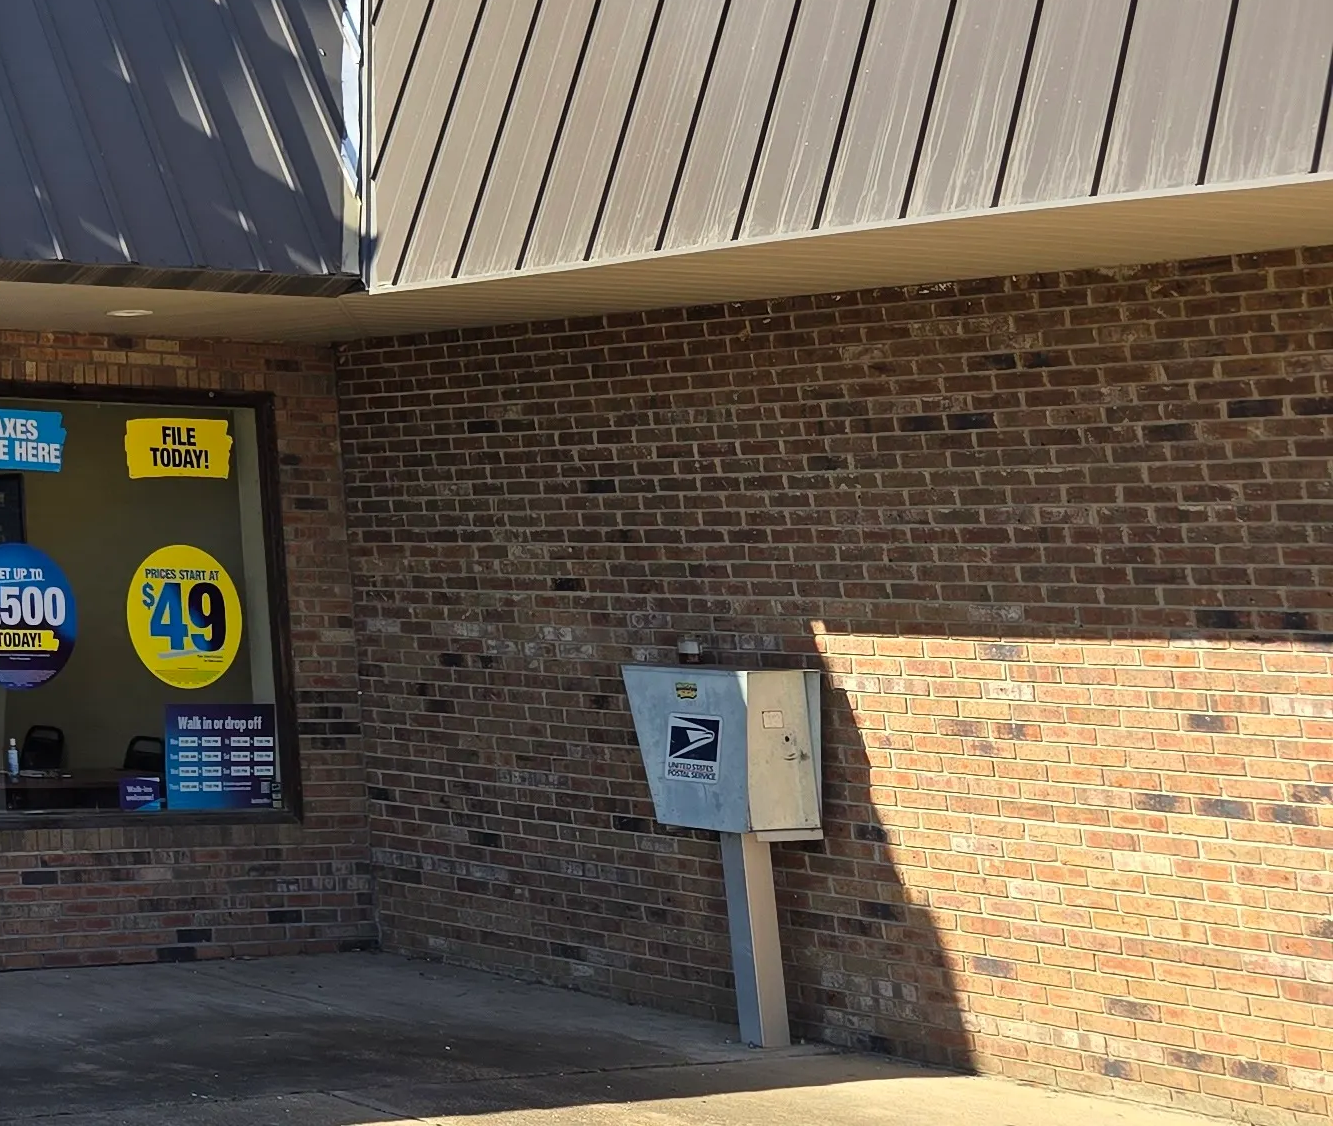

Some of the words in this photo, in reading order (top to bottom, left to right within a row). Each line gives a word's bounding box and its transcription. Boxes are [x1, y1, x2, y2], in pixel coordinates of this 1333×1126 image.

[161, 426, 197, 446] FILE
[15, 441, 61, 464] HERE
[150, 447, 209, 469] TODAY!
[13, 568, 27, 580] UP
[29, 568, 43, 580] TO
[145, 568, 176, 580] PRICES
[179, 570, 206, 580] START
[209, 571, 219, 581] AT
[142, 582, 226, 652] $49
[178, 716, 201, 730] Walk
[203, 716, 212, 730] in
[214, 719, 224, 730] or
[224, 716, 247, 732] drop
[248, 716, 262, 730] off
[668, 762, 691, 770] UNITED
[692, 764, 713, 772] STATES
[668, 769, 690, 778] POSTAL
[691, 771, 716, 780] SERVICE
